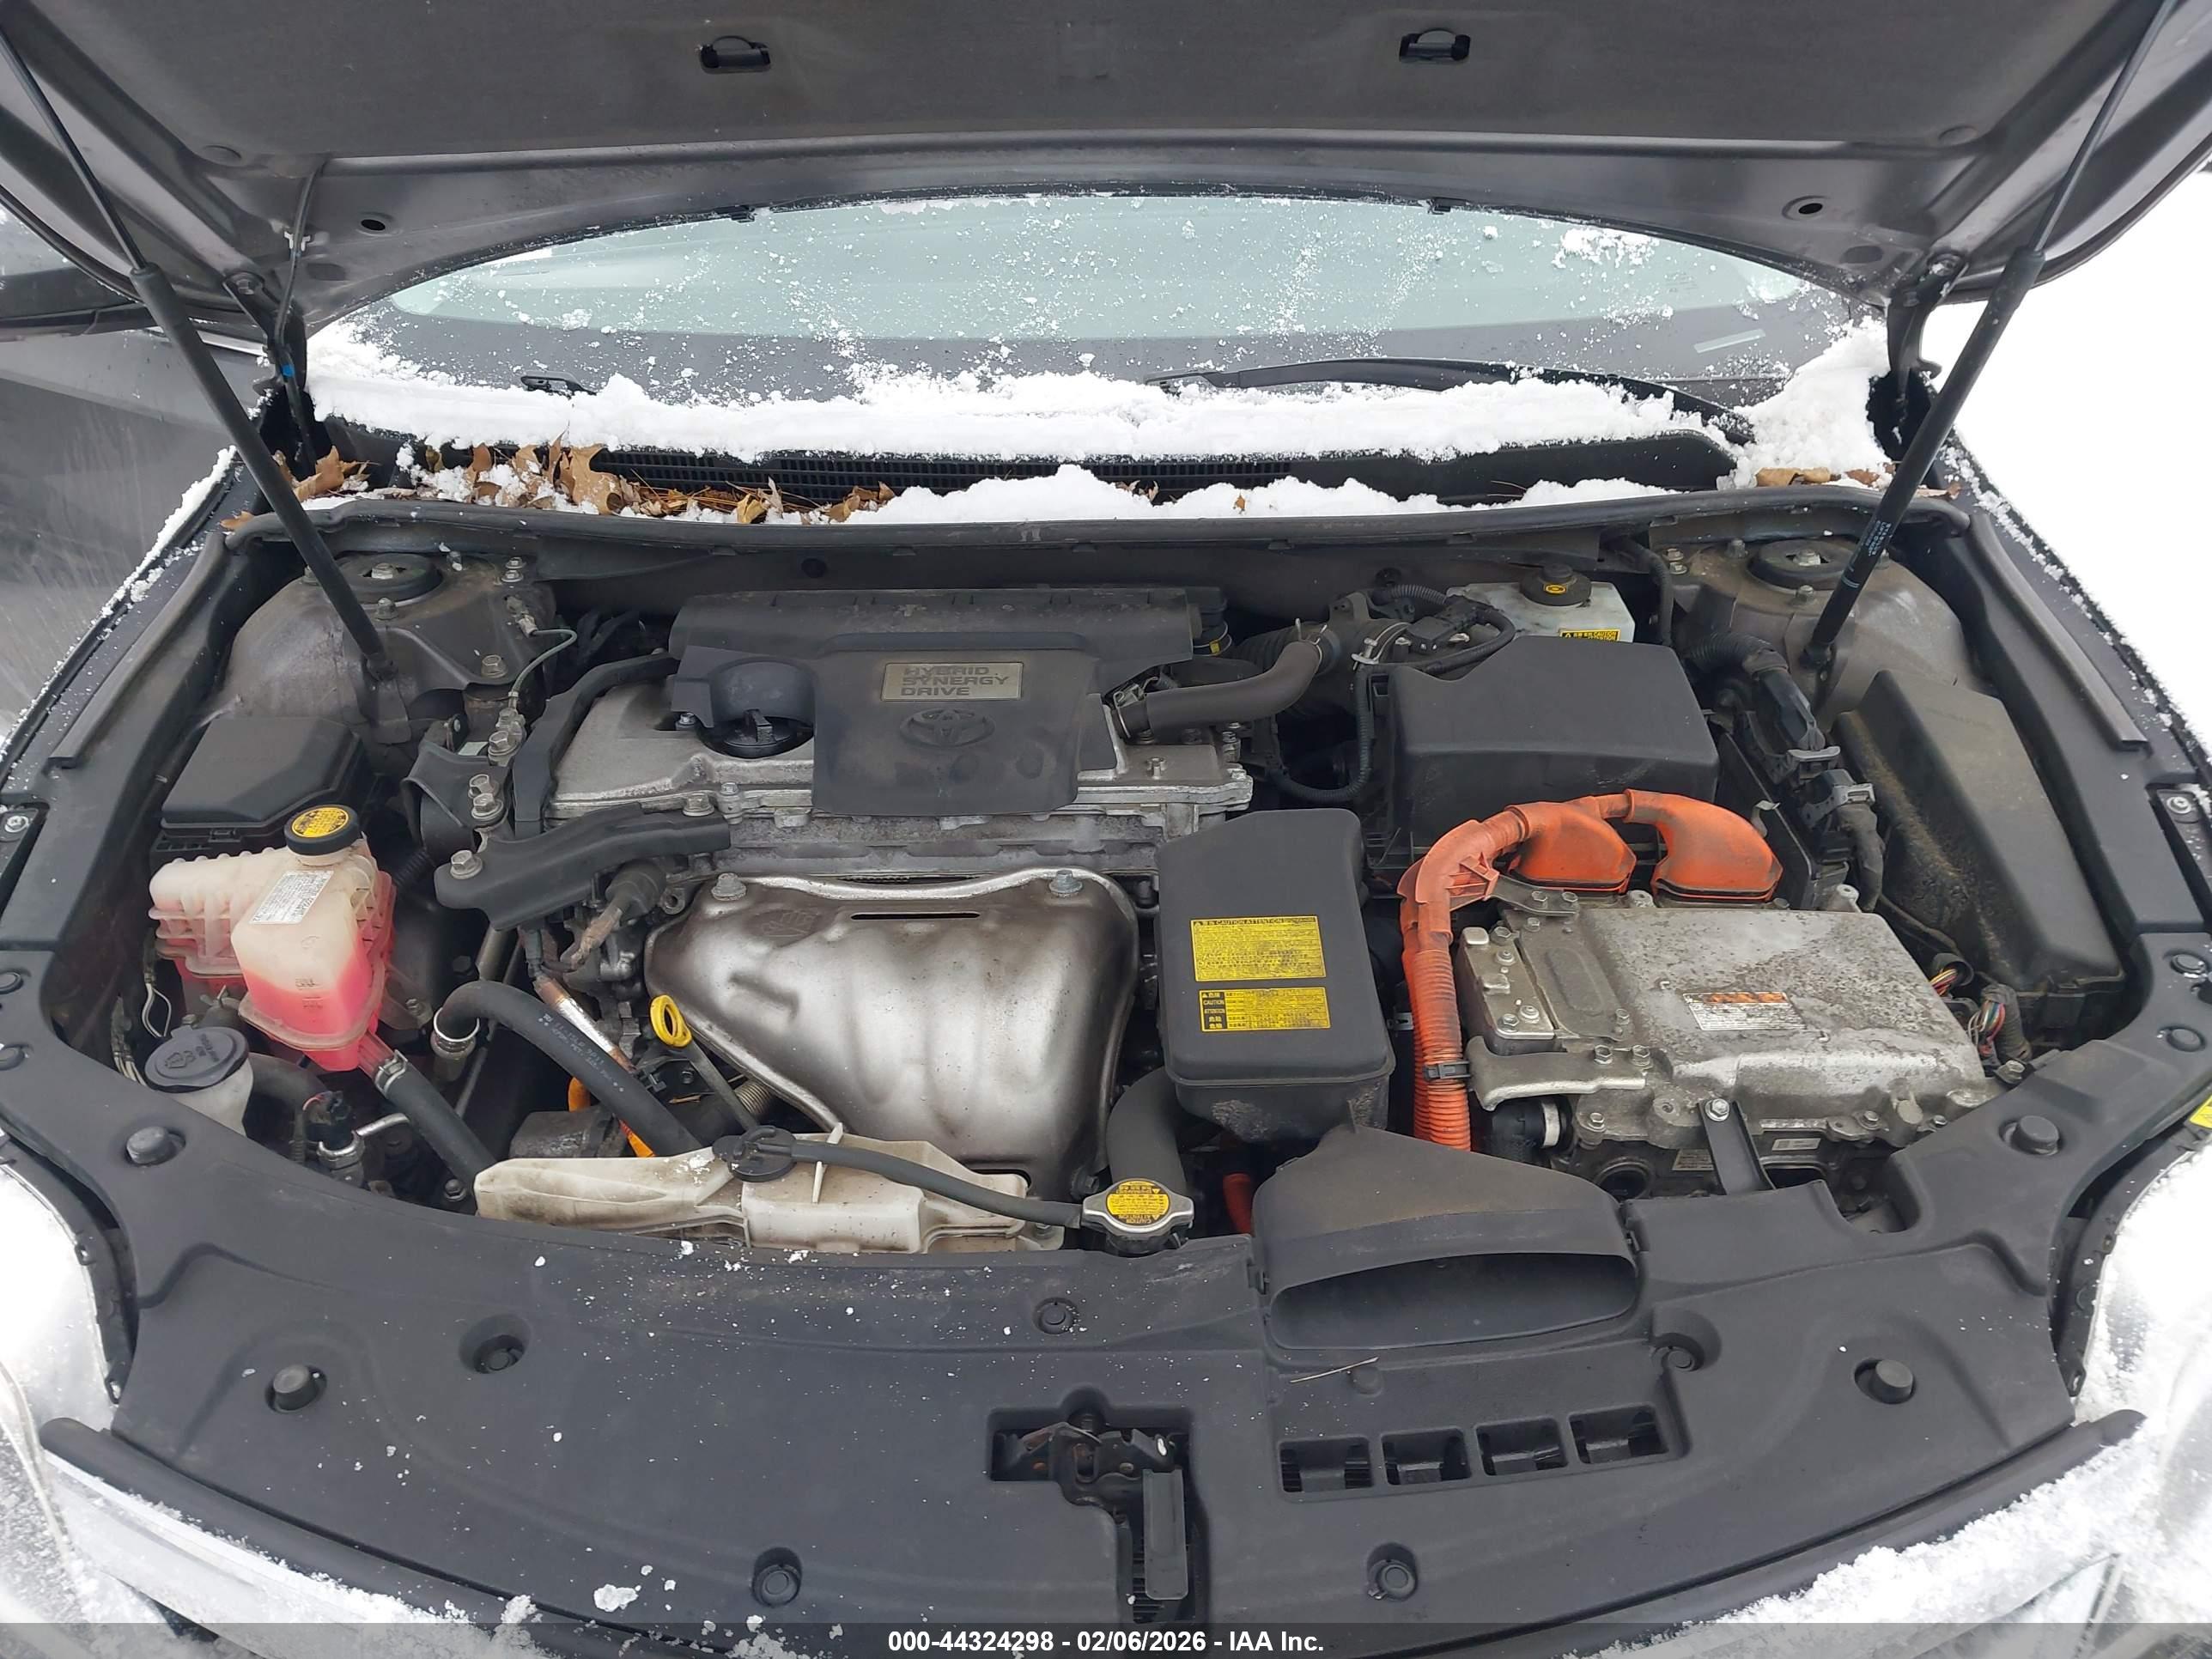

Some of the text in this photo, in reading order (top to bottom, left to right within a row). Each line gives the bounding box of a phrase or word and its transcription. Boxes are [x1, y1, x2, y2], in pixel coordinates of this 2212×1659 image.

[904, 666, 989, 675] HYBRID
[902, 676, 1010, 685] SYNERGY
[900, 687, 969, 696] DRIVE
